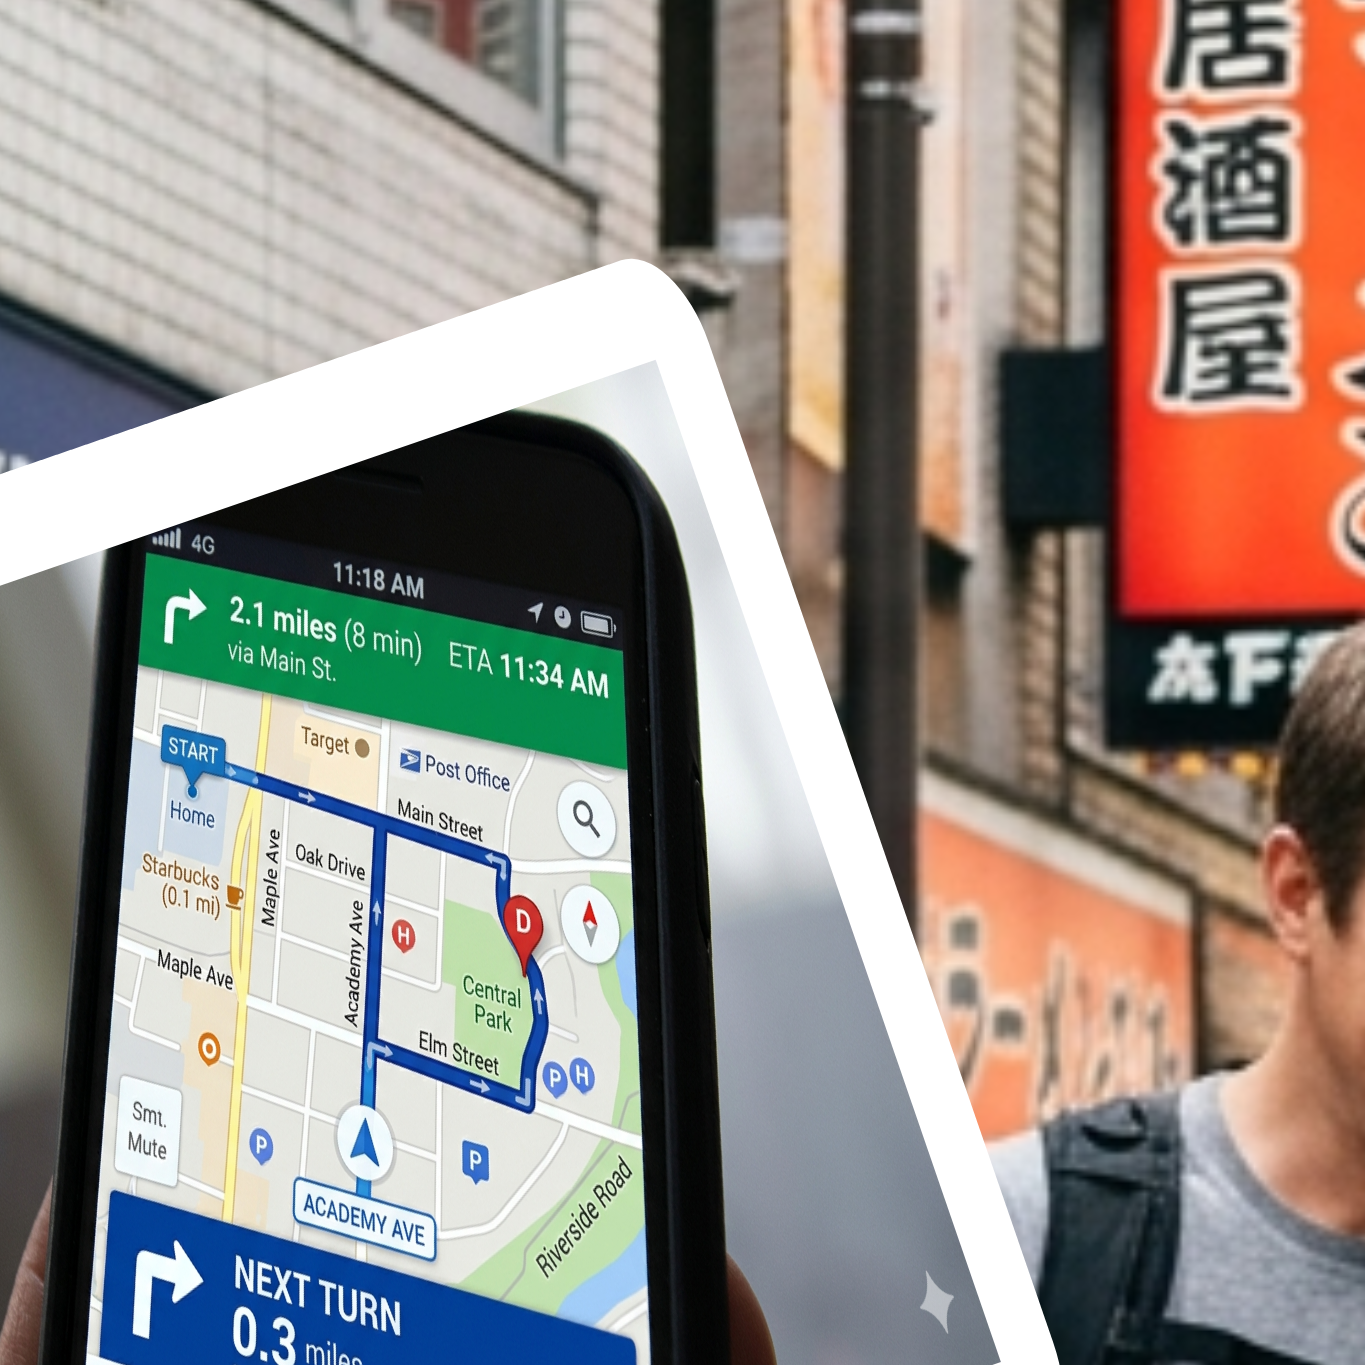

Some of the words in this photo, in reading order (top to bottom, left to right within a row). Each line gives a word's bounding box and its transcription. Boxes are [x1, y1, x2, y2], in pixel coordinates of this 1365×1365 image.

[1157, 0, 1297, 402] 居酒屋
[190, 534, 216, 555] 4G
[333, 561, 386, 592] 11:18
[390, 572, 425, 600] AM
[229, 595, 264, 628] 2.1
[273, 608, 338, 644] miles
[344, 617, 366, 653] (8
[372, 629, 422, 667] min)
[227, 639, 254, 665] via
[259, 644, 306, 676] Main
[311, 655, 337, 683] St.
[449, 641, 494, 676] ETA
[499, 653, 565, 690] 11:34
[570, 667, 610, 699] AM
[168, 736, 219, 765] START
[301, 725, 350, 756] Target
[425, 754, 461, 781] Post
[464, 764, 511, 793] Office
[170, 800, 216, 829] Home
[397, 798, 435, 827] Main
[438, 812, 484, 843] Street
[266, 828, 281, 865] Ave
[295, 843, 323, 868] Oak
[327, 852, 366, 882] Drive
[142, 853, 220, 891] Starbucks
[161, 882, 190, 909] (0.1
[195, 895, 221, 921] mi)
[261, 868, 279, 927] Maple
[349, 899, 364, 936] Ave
[515, 909, 531, 934] D
[157, 948, 203, 986] Maple
[205, 964, 235, 991] Ave
[344, 938, 366, 1028] Academy
[462, 974, 522, 1009] Central
[474, 1003, 513, 1034] Park
[418, 1030, 448, 1058] Elm
[452, 1045, 500, 1077] Street
[131, 1100, 167, 1129] Smt.
[127, 1130, 168, 1160] Mute
[302, 1192, 388, 1235] ACADEMY
[391, 1219, 426, 1247] AVE
[535, 1203, 600, 1280] Riverside
[591, 1154, 634, 1209] Road
[234, 1253, 311, 1309] NEXT
[317, 1278, 402, 1337] TURN
